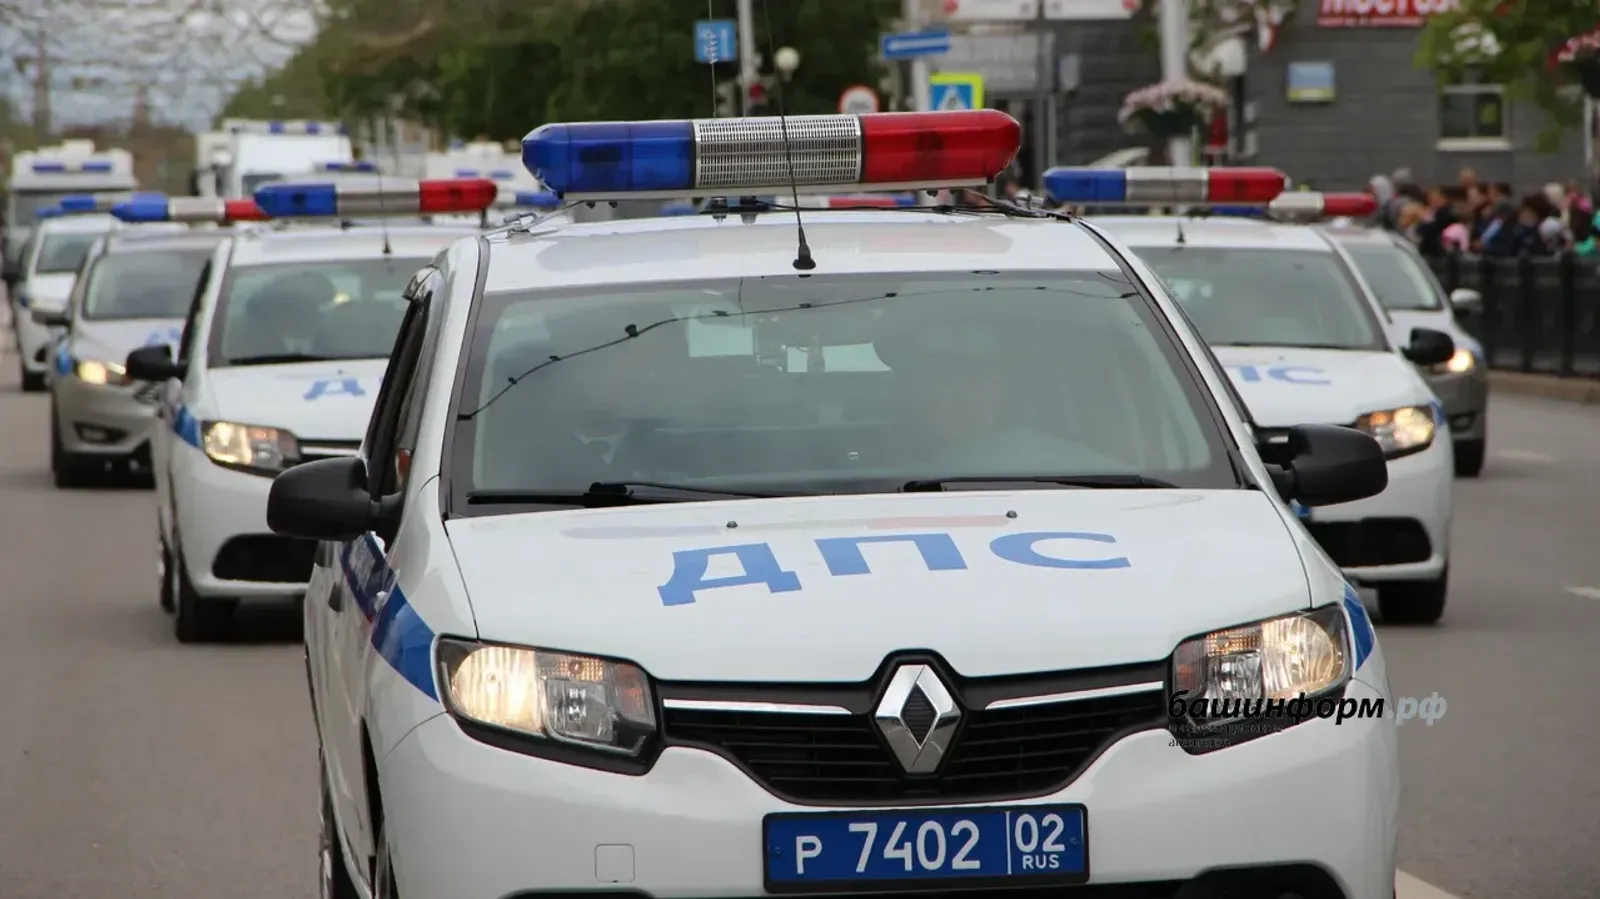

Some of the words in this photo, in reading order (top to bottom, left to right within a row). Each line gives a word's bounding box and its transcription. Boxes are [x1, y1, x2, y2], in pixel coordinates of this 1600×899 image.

[657, 531, 1131, 607] ДПС
[796, 835, 823, 875] Р
[848, 819, 981, 873] 7402
[1015, 812, 1066, 853] 02
[1022, 854, 1061, 870] RUS
